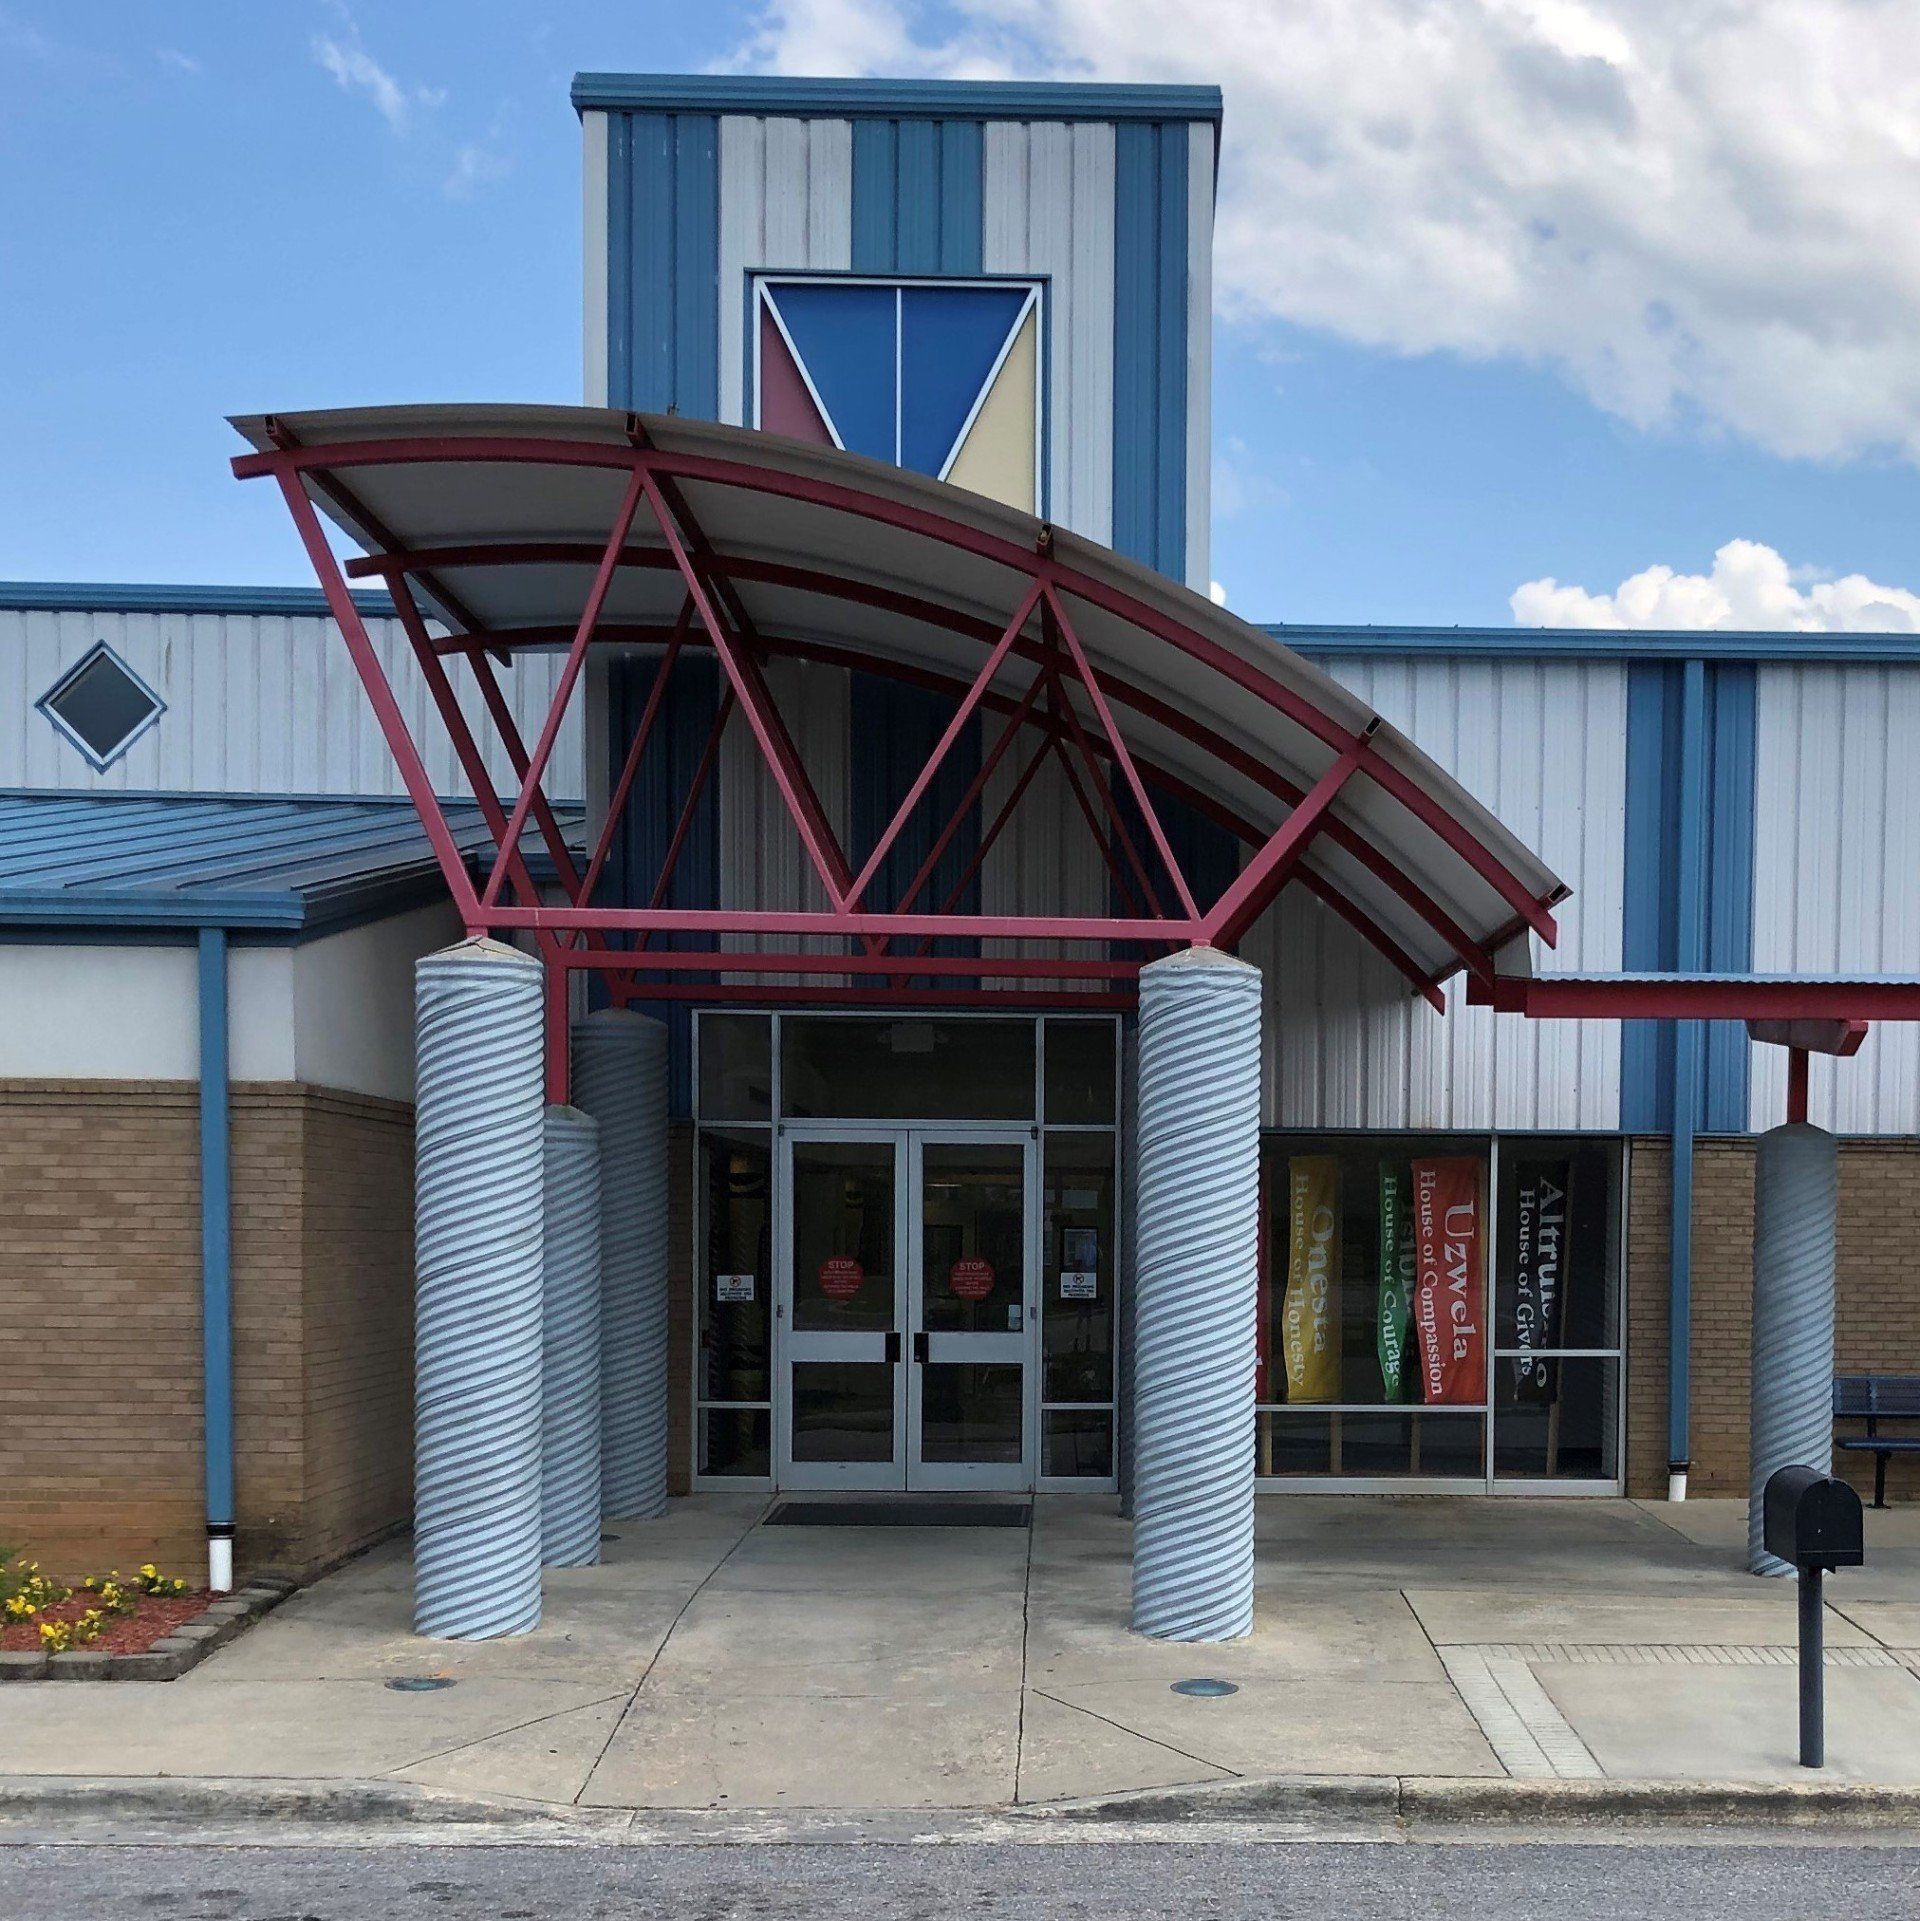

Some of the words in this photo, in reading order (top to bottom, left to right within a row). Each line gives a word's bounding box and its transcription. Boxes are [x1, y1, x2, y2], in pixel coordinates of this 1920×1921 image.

[1294, 1175, 1309, 1250] House
[1383, 1176, 1398, 1252] House
[1420, 1170, 1436, 1239] House
[1519, 1189, 1536, 1265] House
[828, 1260, 854, 1269] STOP
[960, 1262, 985, 1270] STOP
[1308, 1206, 1335, 1354] Onesta
[1385, 1259, 1395, 1283] of
[1423, 1243, 1438, 1266] of
[1443, 1201, 1477, 1361] Uzwela
[1518, 1272, 1533, 1298] of
[1288, 1287, 1306, 1387] Honesty
[1382, 1290, 1401, 1387] Courage
[1420, 1270, 1447, 1395] Compassion
